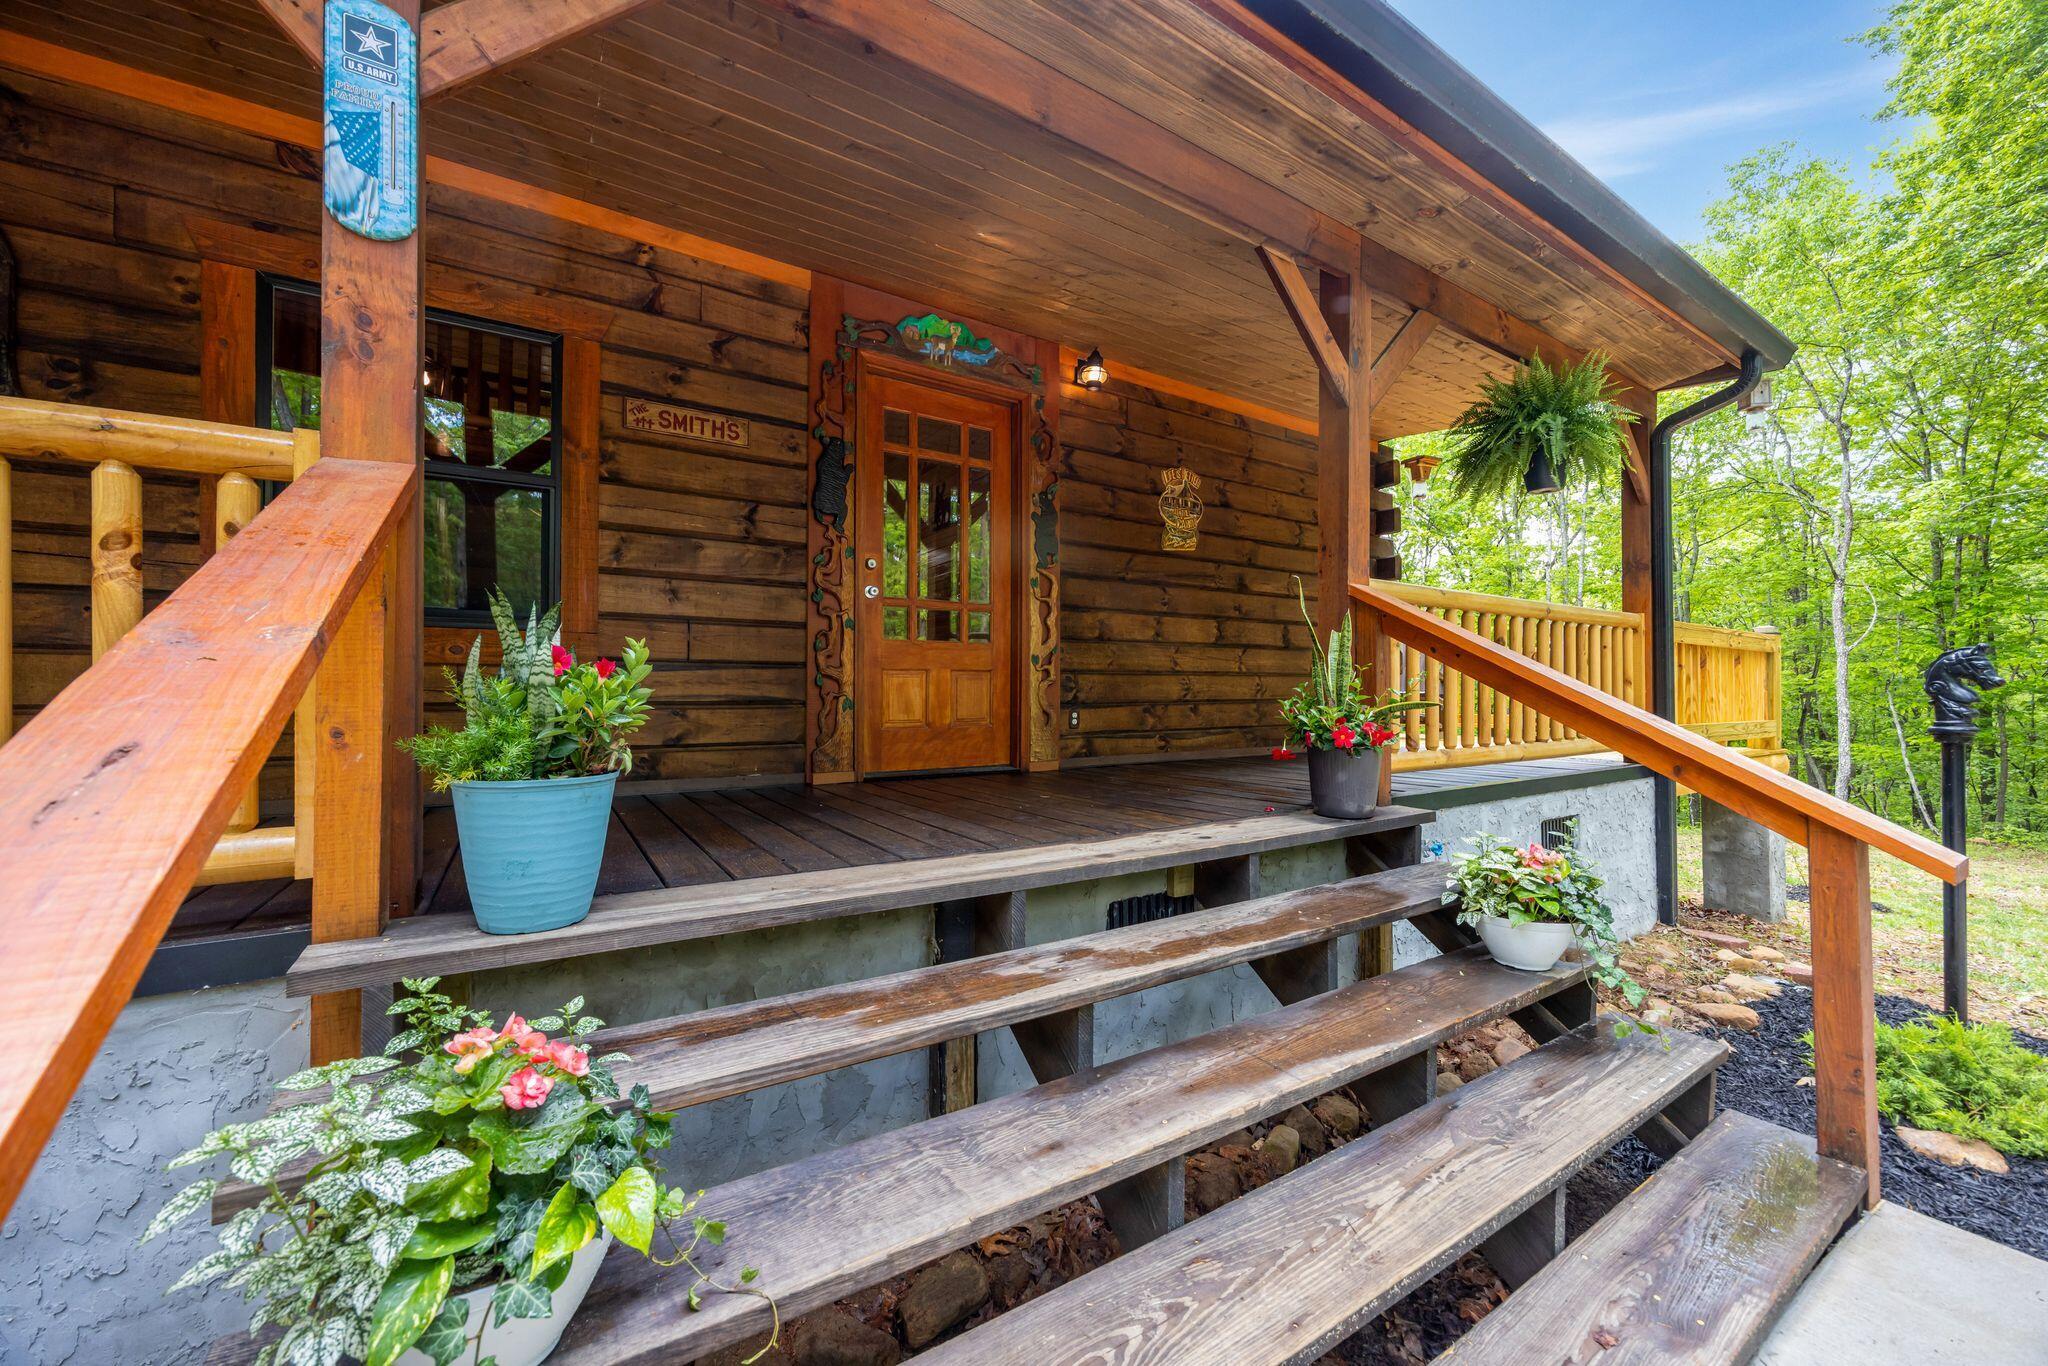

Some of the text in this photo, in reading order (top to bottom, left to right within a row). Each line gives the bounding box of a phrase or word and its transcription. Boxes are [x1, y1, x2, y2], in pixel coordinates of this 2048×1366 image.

[331, 88, 382, 110] FAMILY
[335, 79, 379, 101] PROUD
[628, 402, 741, 441] THE SMITH'S
